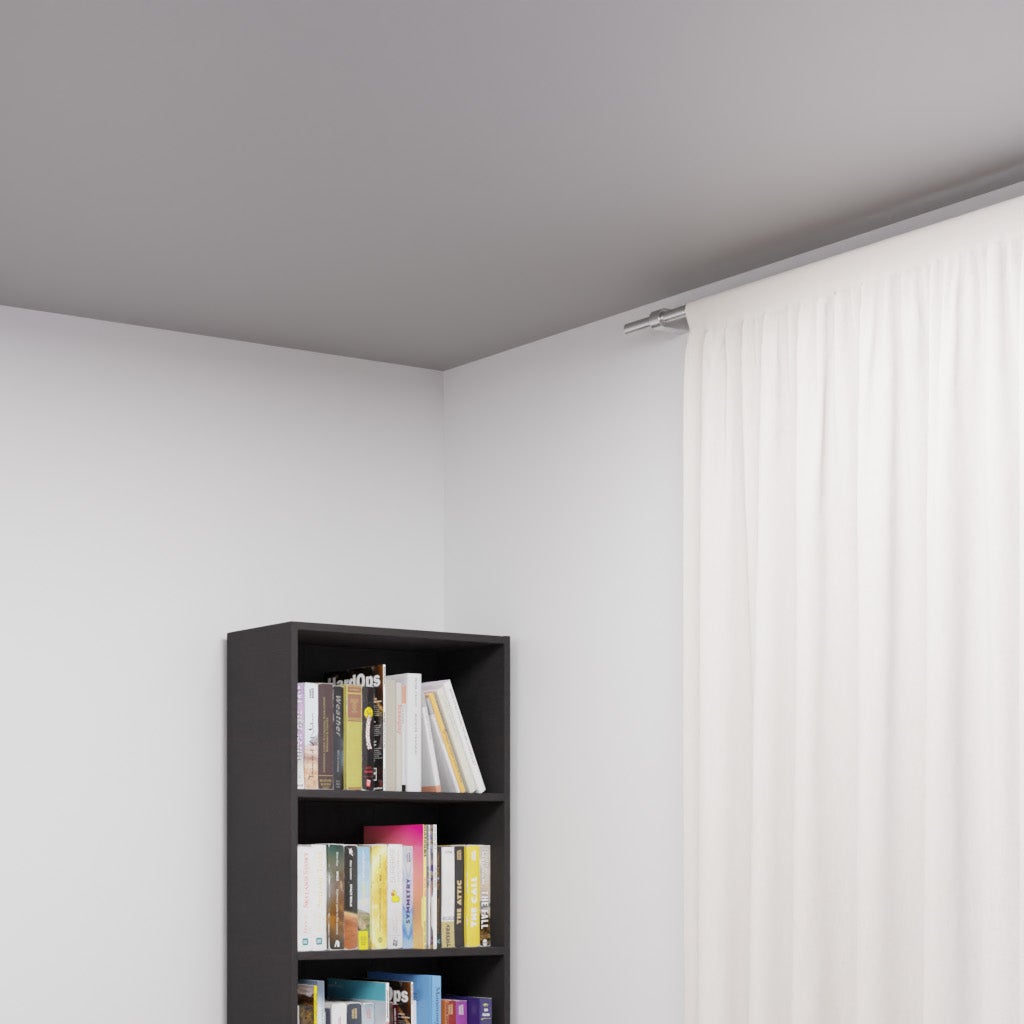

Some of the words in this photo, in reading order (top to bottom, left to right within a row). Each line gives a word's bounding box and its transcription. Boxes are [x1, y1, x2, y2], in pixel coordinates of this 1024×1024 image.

[470, 877, 478, 904] CALL
[480, 891, 489, 907] THE
[470, 907, 478, 927] THE
[480, 909, 489, 930] FALL
